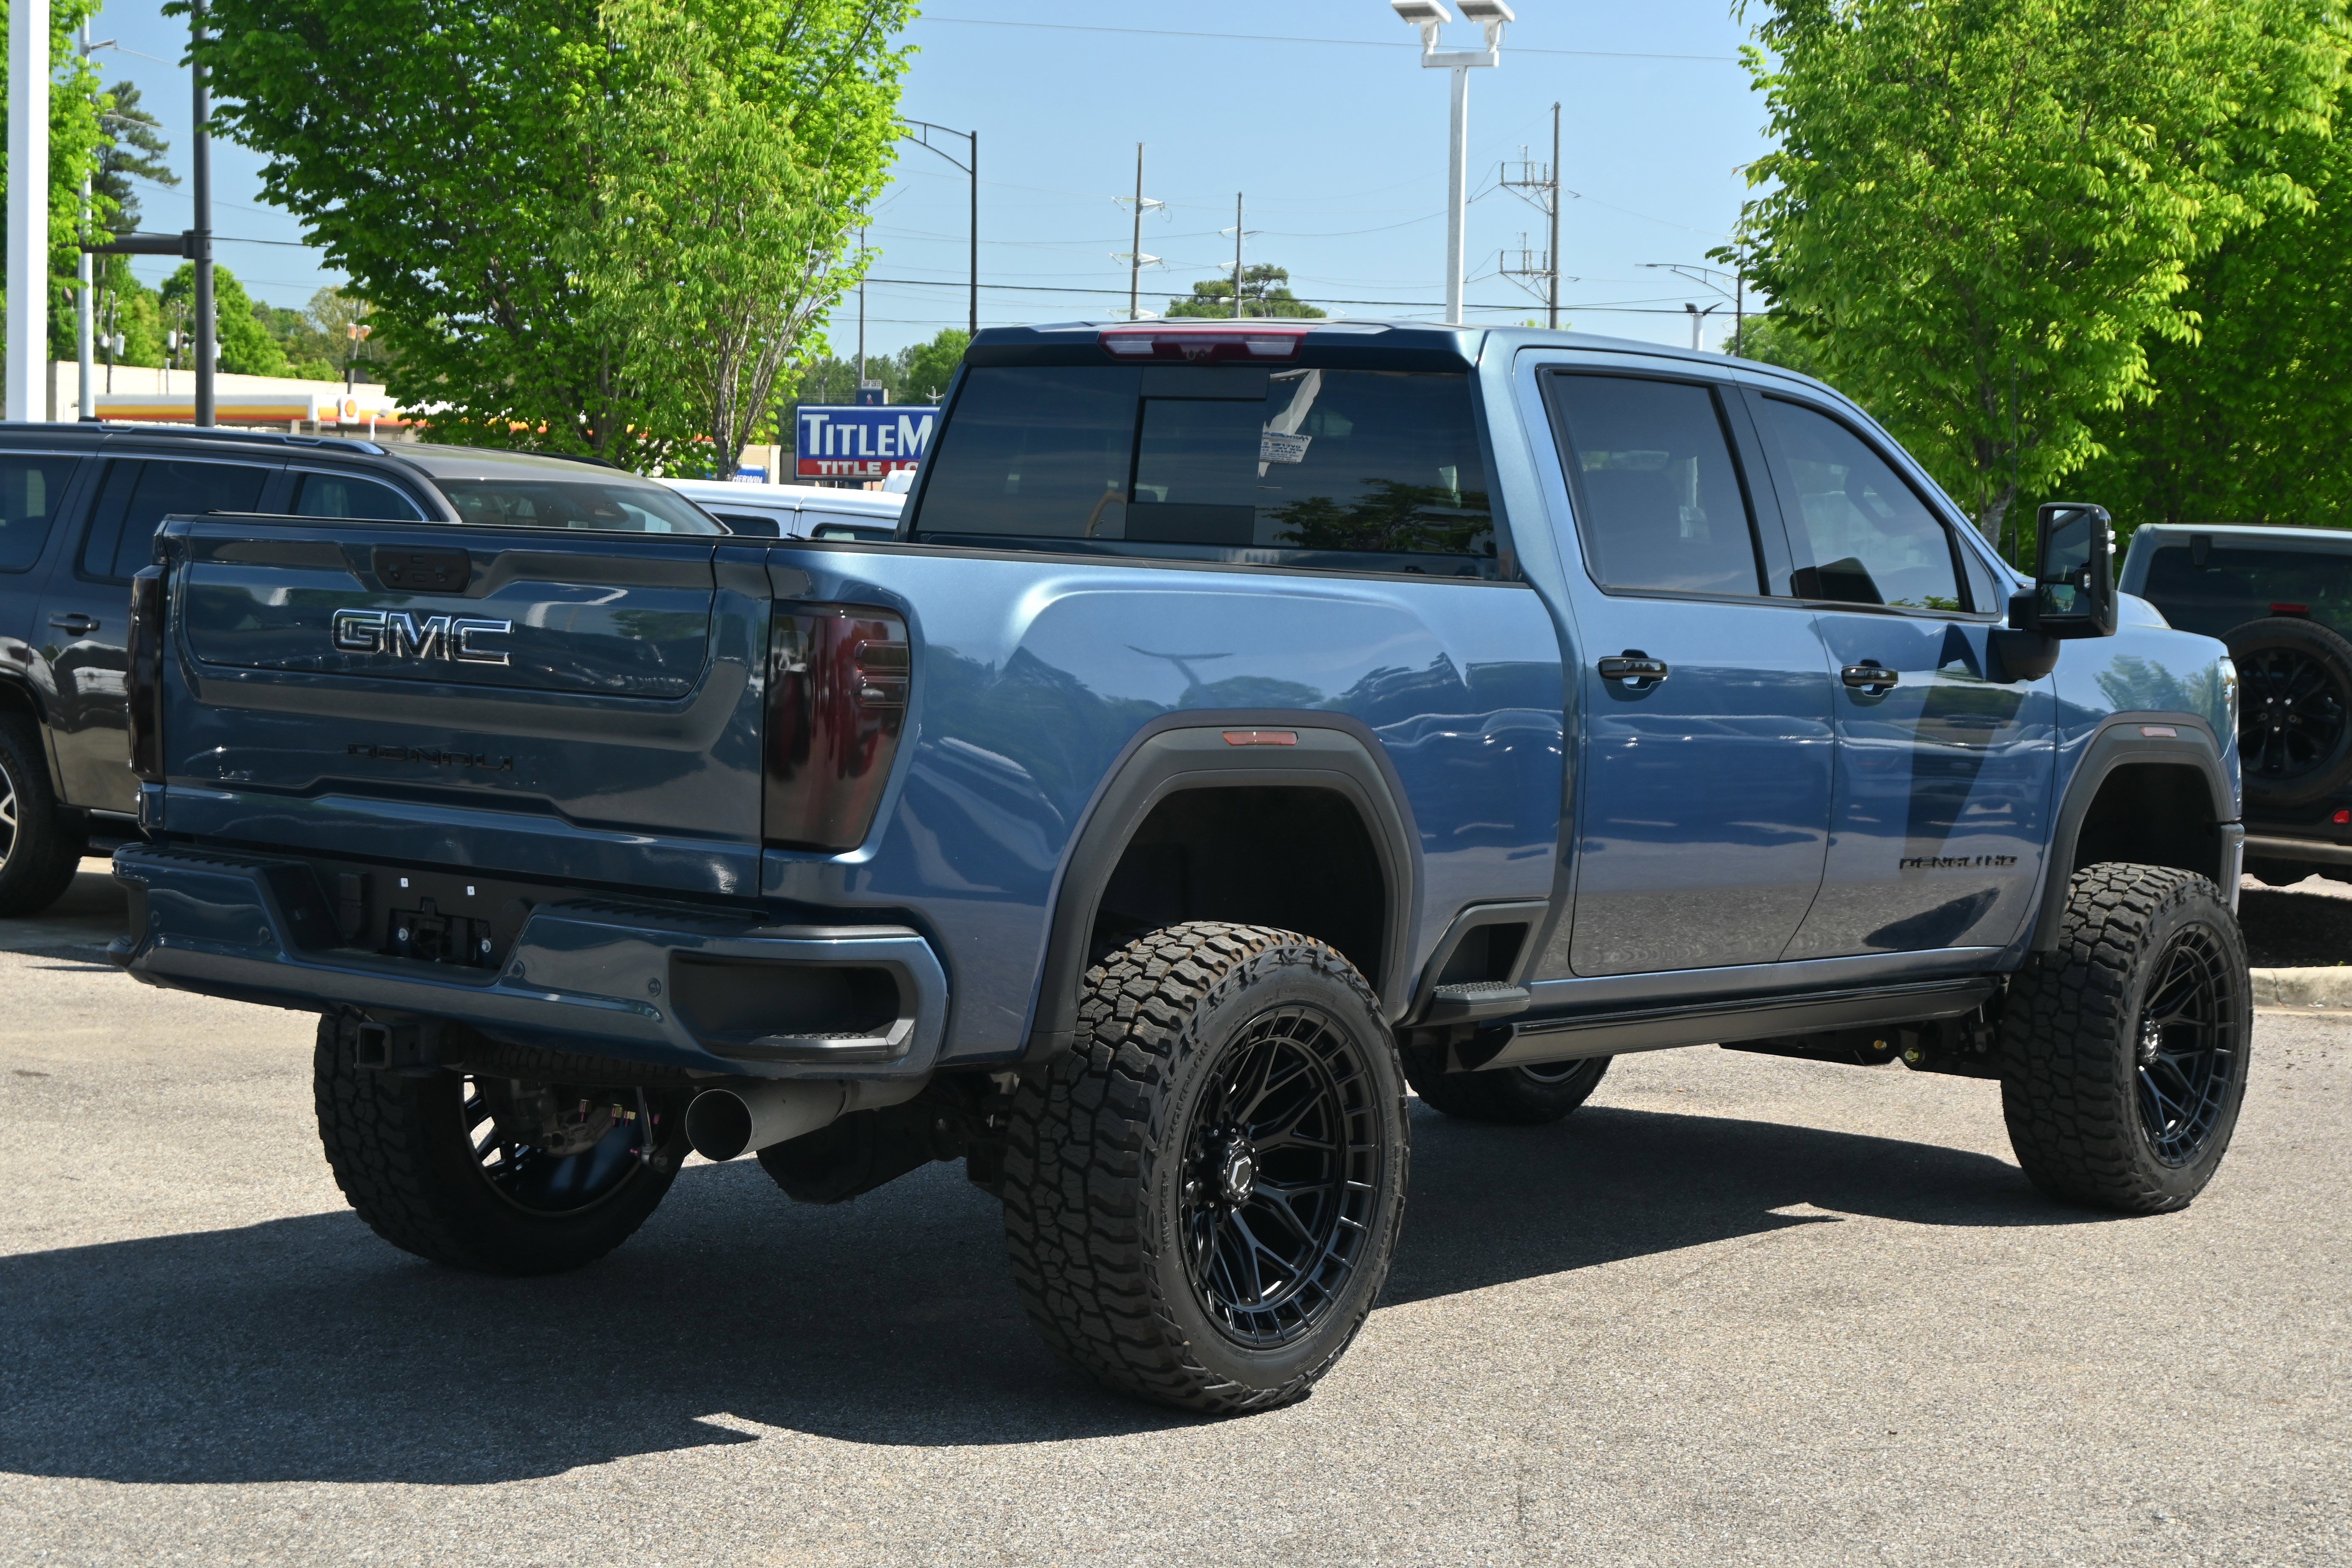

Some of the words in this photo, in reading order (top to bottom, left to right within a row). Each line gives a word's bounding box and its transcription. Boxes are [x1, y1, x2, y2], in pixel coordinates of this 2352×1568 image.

[801, 414, 933, 456] TITLEM
[733, 474, 763, 483] HERWIN
[817, 461, 882, 475] TITLE
[332, 607, 514, 666] GMC
[348, 743, 513, 770] DENALI
[1899, 855, 1983, 869] DENALI
[1160, 1169, 1171, 1254] MICKEY
[1166, 1041, 1210, 1153] THOMPSON
